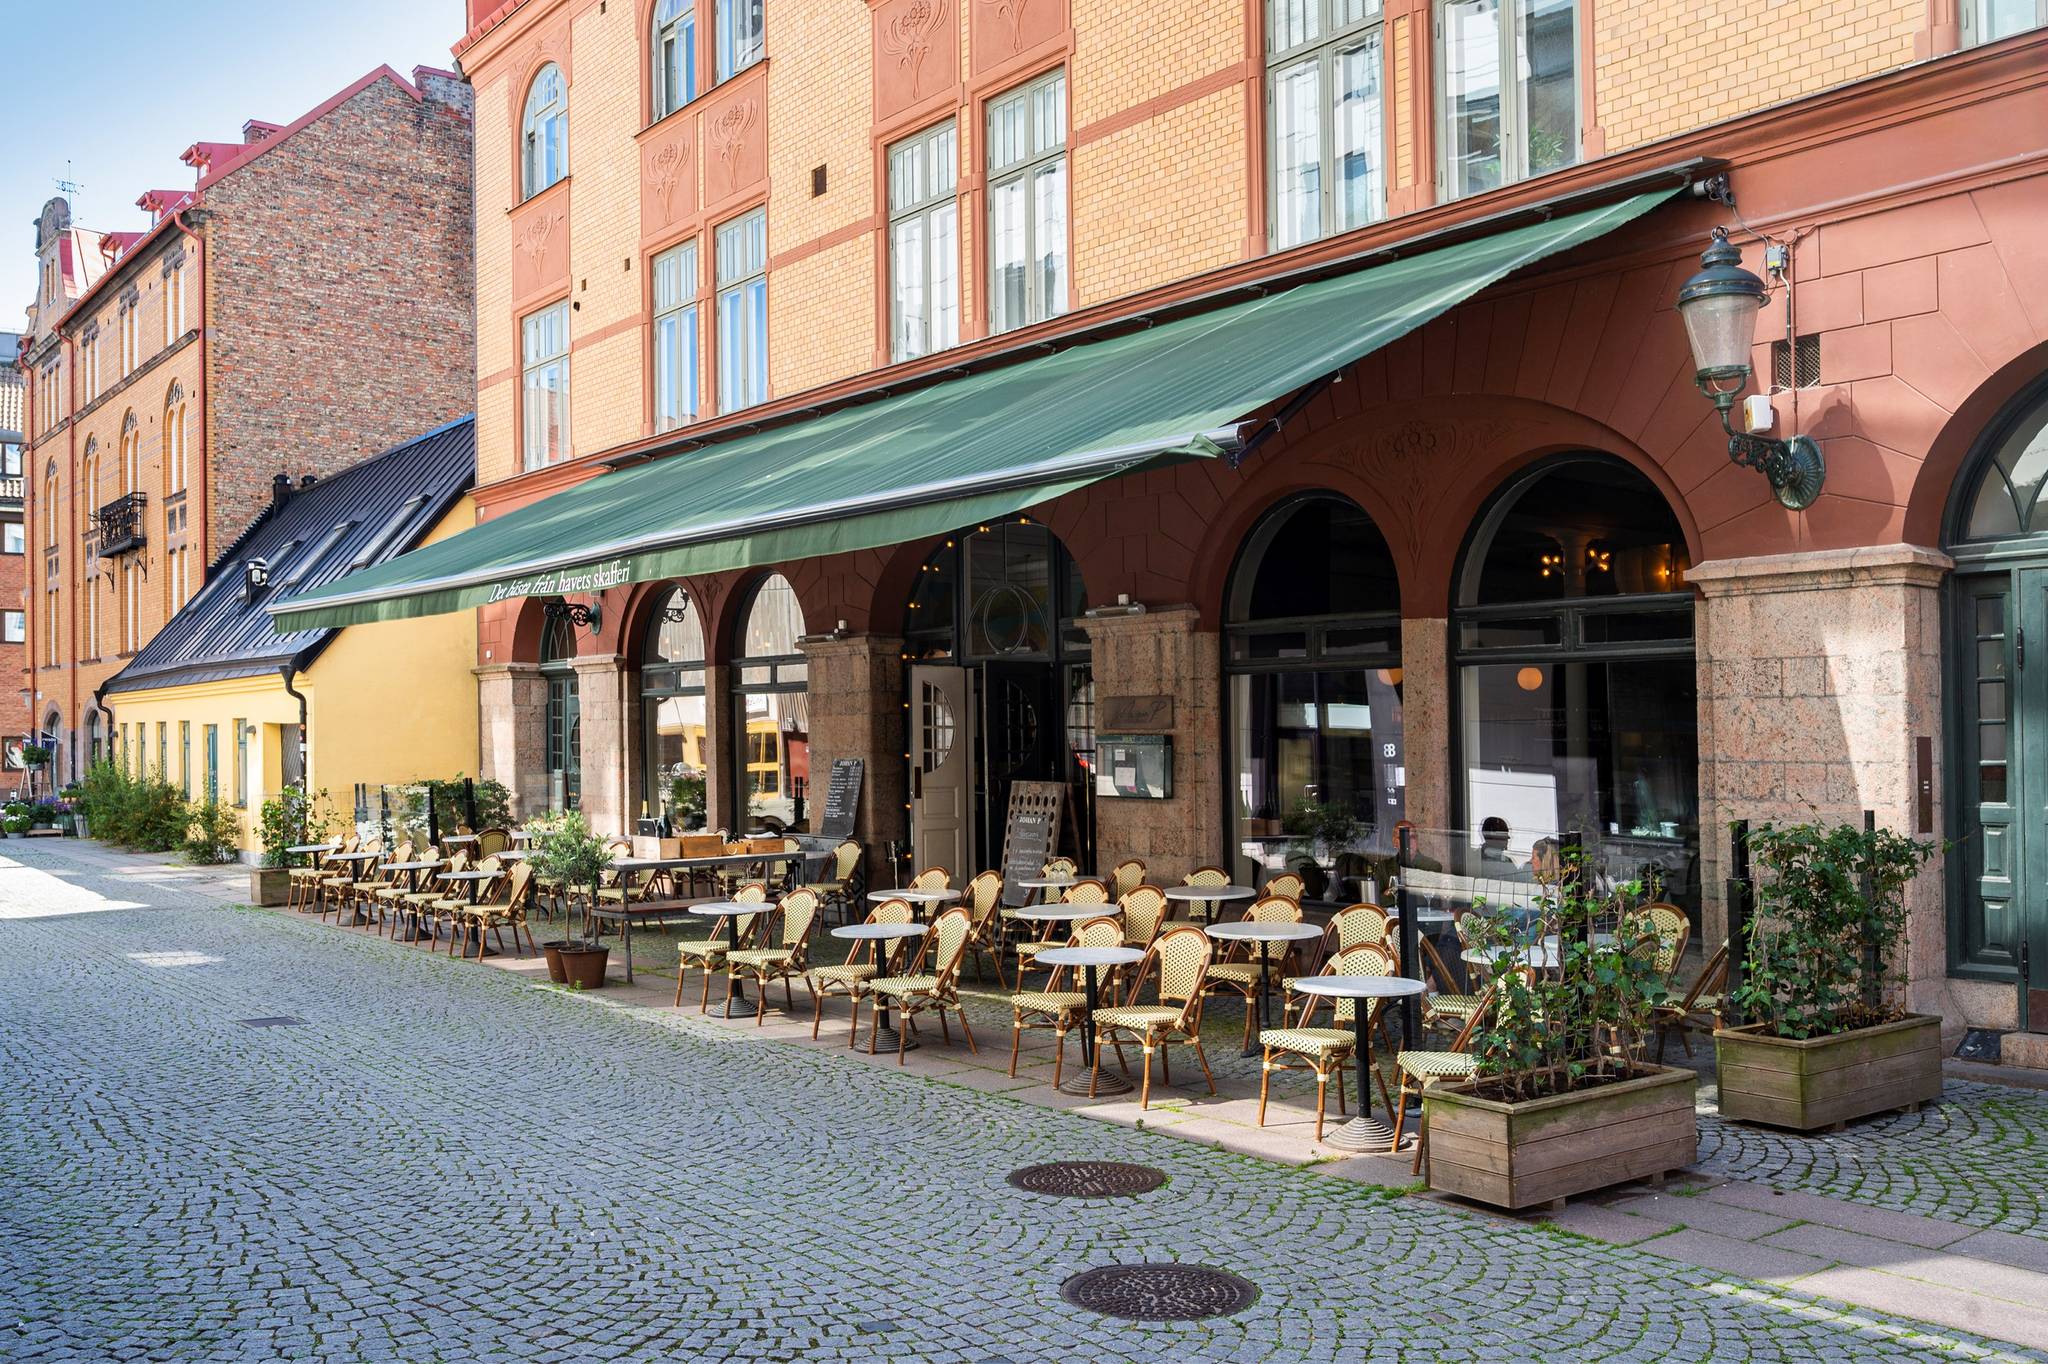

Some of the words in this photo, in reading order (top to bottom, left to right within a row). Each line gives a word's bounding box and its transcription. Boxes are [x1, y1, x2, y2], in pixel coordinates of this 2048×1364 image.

[488, 583, 507, 602] Det
[506, 579, 532, 596] bästa
[531, 574, 556, 594] från
[556, 570, 591, 593] havets
[592, 560, 631, 587] skafferi
